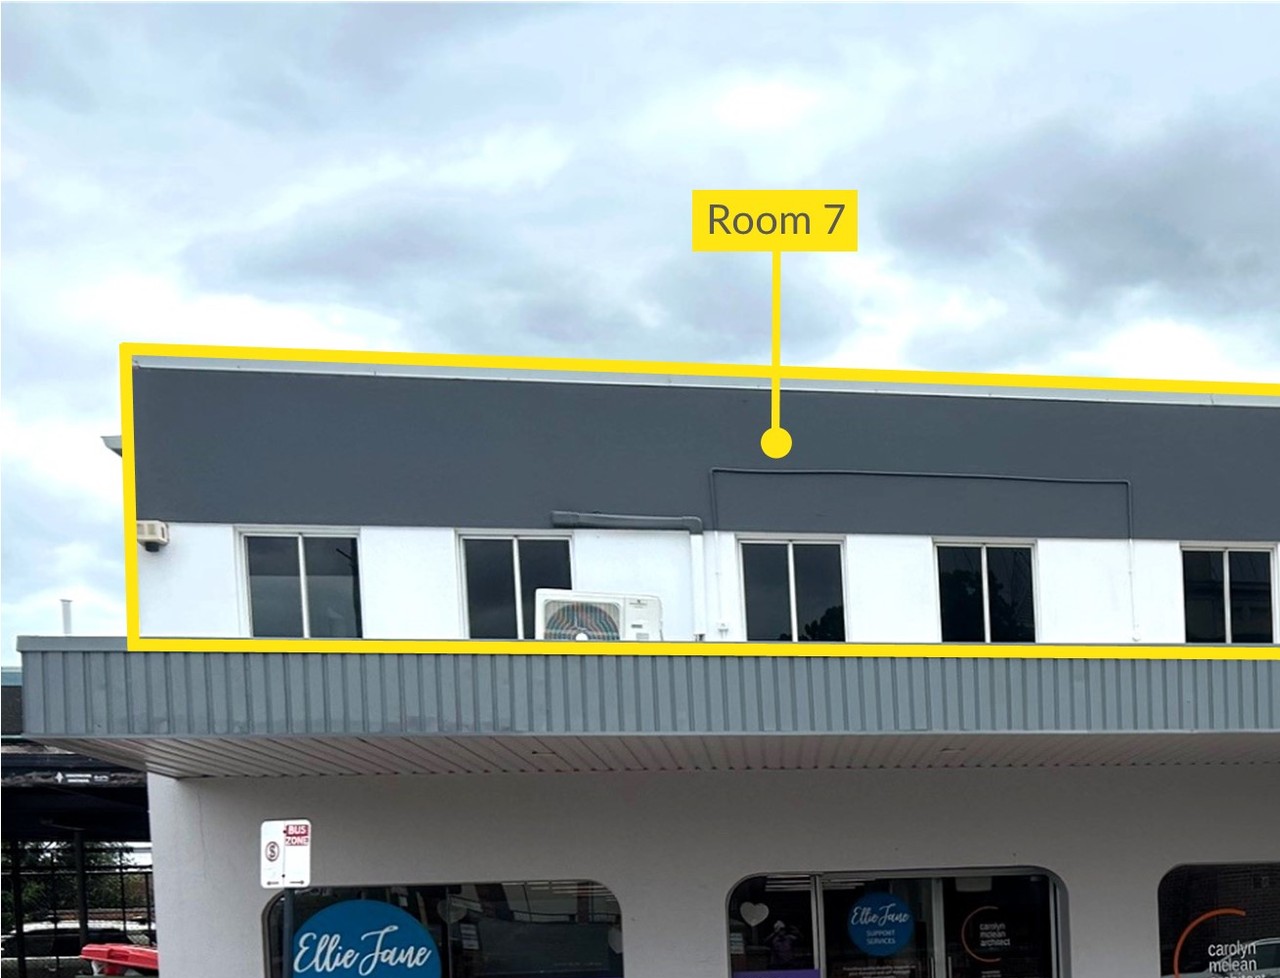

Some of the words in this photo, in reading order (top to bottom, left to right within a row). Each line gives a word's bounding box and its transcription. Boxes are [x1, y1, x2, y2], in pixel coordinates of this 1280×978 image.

[287, 825, 307, 835] BUS
[285, 836, 309, 846] ZONE
[850, 906, 879, 925] Ellie
[293, 932, 359, 973] Ellie
[358, 925, 432, 976] Jane
[1207, 940, 1257, 959] carolyn
[1208, 956, 1258, 972] mclean
